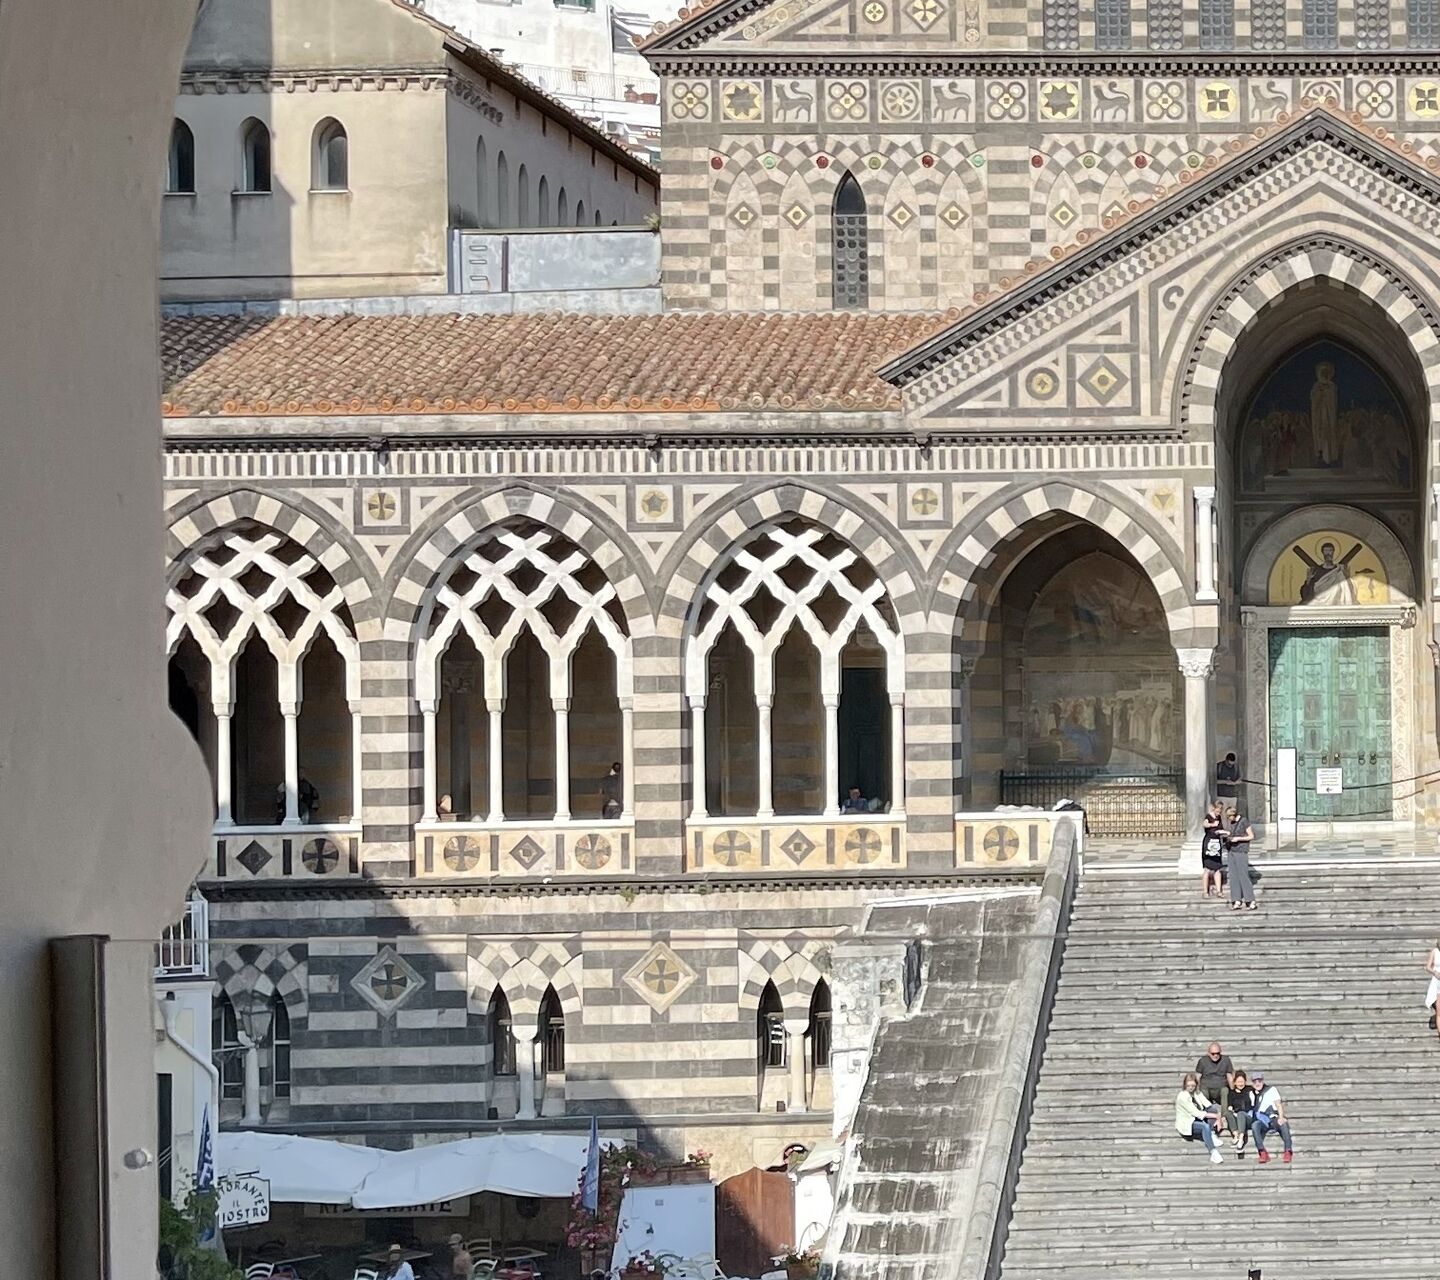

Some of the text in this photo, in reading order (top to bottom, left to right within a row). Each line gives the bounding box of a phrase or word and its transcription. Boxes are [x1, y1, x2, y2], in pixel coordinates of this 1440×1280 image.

[218, 1180, 265, 1206] TORANTE
[232, 1200, 240, 1208] IL
[222, 1206, 268, 1223] IOSTRO
